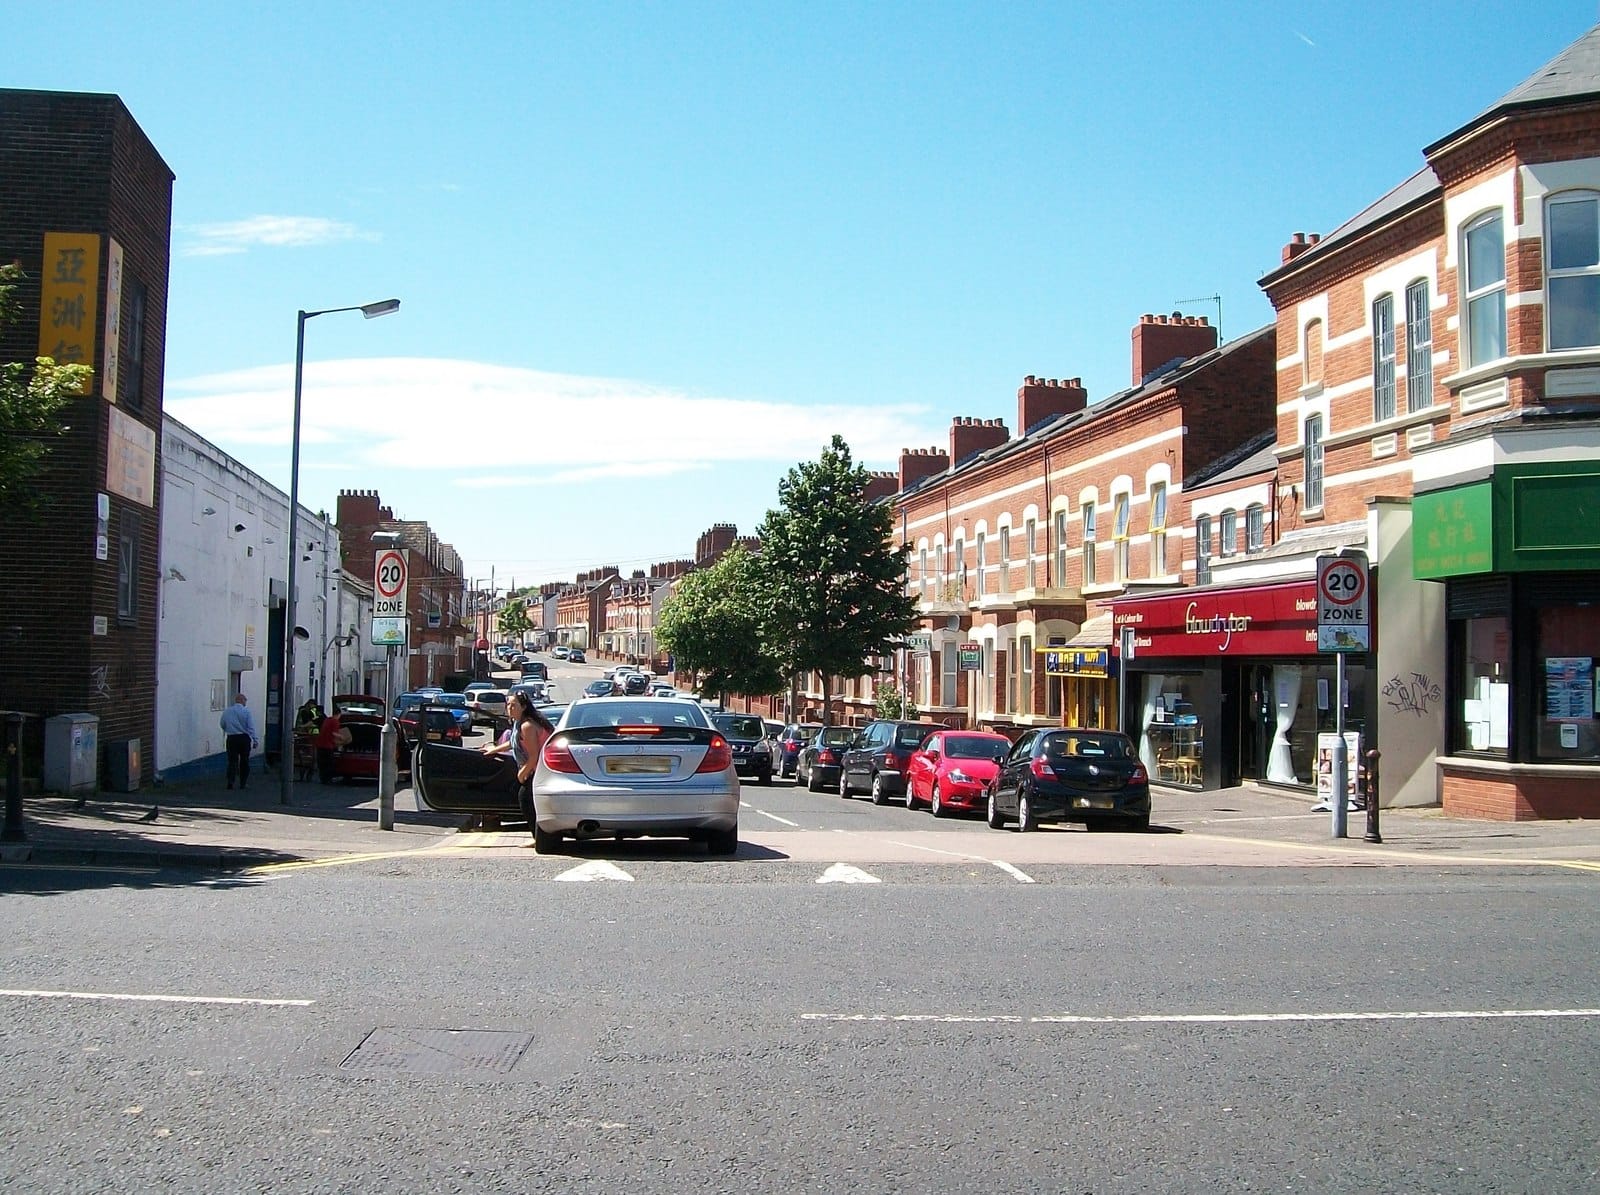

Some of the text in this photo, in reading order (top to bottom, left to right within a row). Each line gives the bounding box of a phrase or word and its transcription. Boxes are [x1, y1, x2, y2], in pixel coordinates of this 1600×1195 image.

[381, 566, 400, 582] 20
[1328, 573, 1357, 590] 20
[377, 601, 402, 612] ZONE
[1295, 598, 1317, 612] blowdr
[1323, 609, 1363, 620] ZONE
